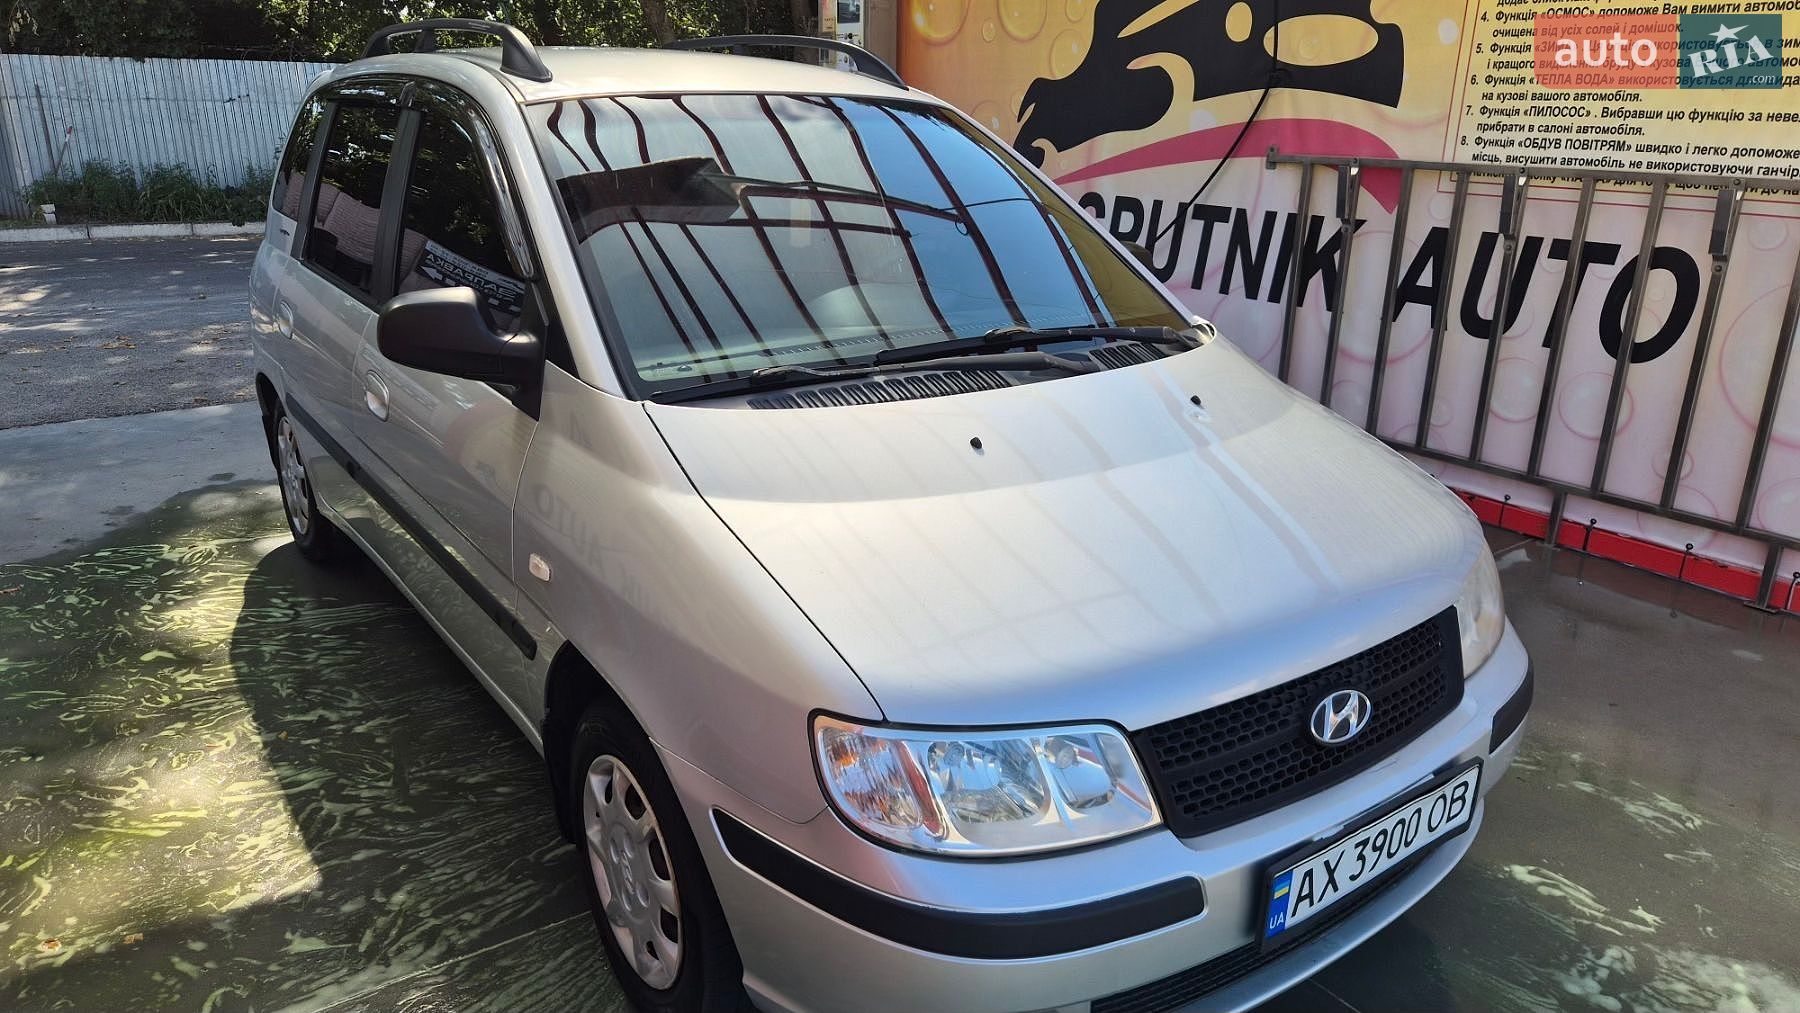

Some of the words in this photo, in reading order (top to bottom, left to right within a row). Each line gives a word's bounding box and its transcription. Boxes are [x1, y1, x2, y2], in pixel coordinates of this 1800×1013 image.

[1481, 11, 1489, 21] 4.
[1495, 9, 1538, 23] Функція
[1541, 7, 1594, 19] «ОСМОС»
[1597, 5, 1659, 19] допоможе
[1662, 3, 1688, 15] Вам
[1690, 2, 1741, 14] вимити
[1492, 27, 1538, 38] очищена
[1541, 25, 1558, 38] від
[1560, 25, 1582, 38] усіх
[1585, 23, 1620, 35] солей
[1628, 21, 1684, 35] домішок.
[1475, 43, 1484, 54] 5.
[1490, 42, 1532, 56] Функція
[1765, 39, 1774, 49] в
[1492, 60, 1535, 71] кращого
[1470, 74, 1479, 85] 6.
[1485, 74, 1526, 87] Функція
[1529, 74, 1572, 85] «ТЕПЛА
[1575, 73, 1614, 87] ВОДА»
[1618, 74, 1733, 87] використовується
[1482, 91, 1493, 100] на
[1497, 90, 1529, 103] кузові
[1531, 91, 1570, 101] вашого
[1573, 90, 1642, 102] автомобіля.
[1465, 105, 1474, 116] 7.
[1480, 105, 1520, 118] Функція
[1523, 106, 1591, 118] «ПИЛОСОС»
[1601, 106, 1663, 121] Вибравши
[1666, 110, 1685, 121] цю
[1688, 109, 1745, 123] функцію
[1748, 112, 1762, 122] за
[1766, 112, 1800, 123] неве
[1477, 121, 1525, 133] прибрати
[1528, 124, 1534, 132] в
[1537, 123, 1573, 133] салоні
[1576, 123, 1645, 136] автомобіля.
[1461, 136, 1469, 146] 8.
[1474, 136, 1515, 149] Функція
[1518, 137, 1561, 150] «ОБДУВ
[1565, 138, 1632, 152] ПОВІТРЯМ»
[1635, 144, 1682, 155] швидко
[1692, 145, 1727, 156] легко
[1730, 147, 1800, 160] допоможе
[1505, 154, 1557, 166] висушити
[1560, 156, 1625, 168] автомобіль
[1629, 160, 1643, 169] не
[1646, 160, 1755, 175] використовуючи
[1757, 164, 1800, 179] ганчір
[1393, 226, 1701, 364] AUTO
[1290, 850, 1345, 917] AX
[1348, 808, 1422, 882] 3900
[1428, 781, 1469, 833] OB
[1269, 914, 1284, 929] UA
